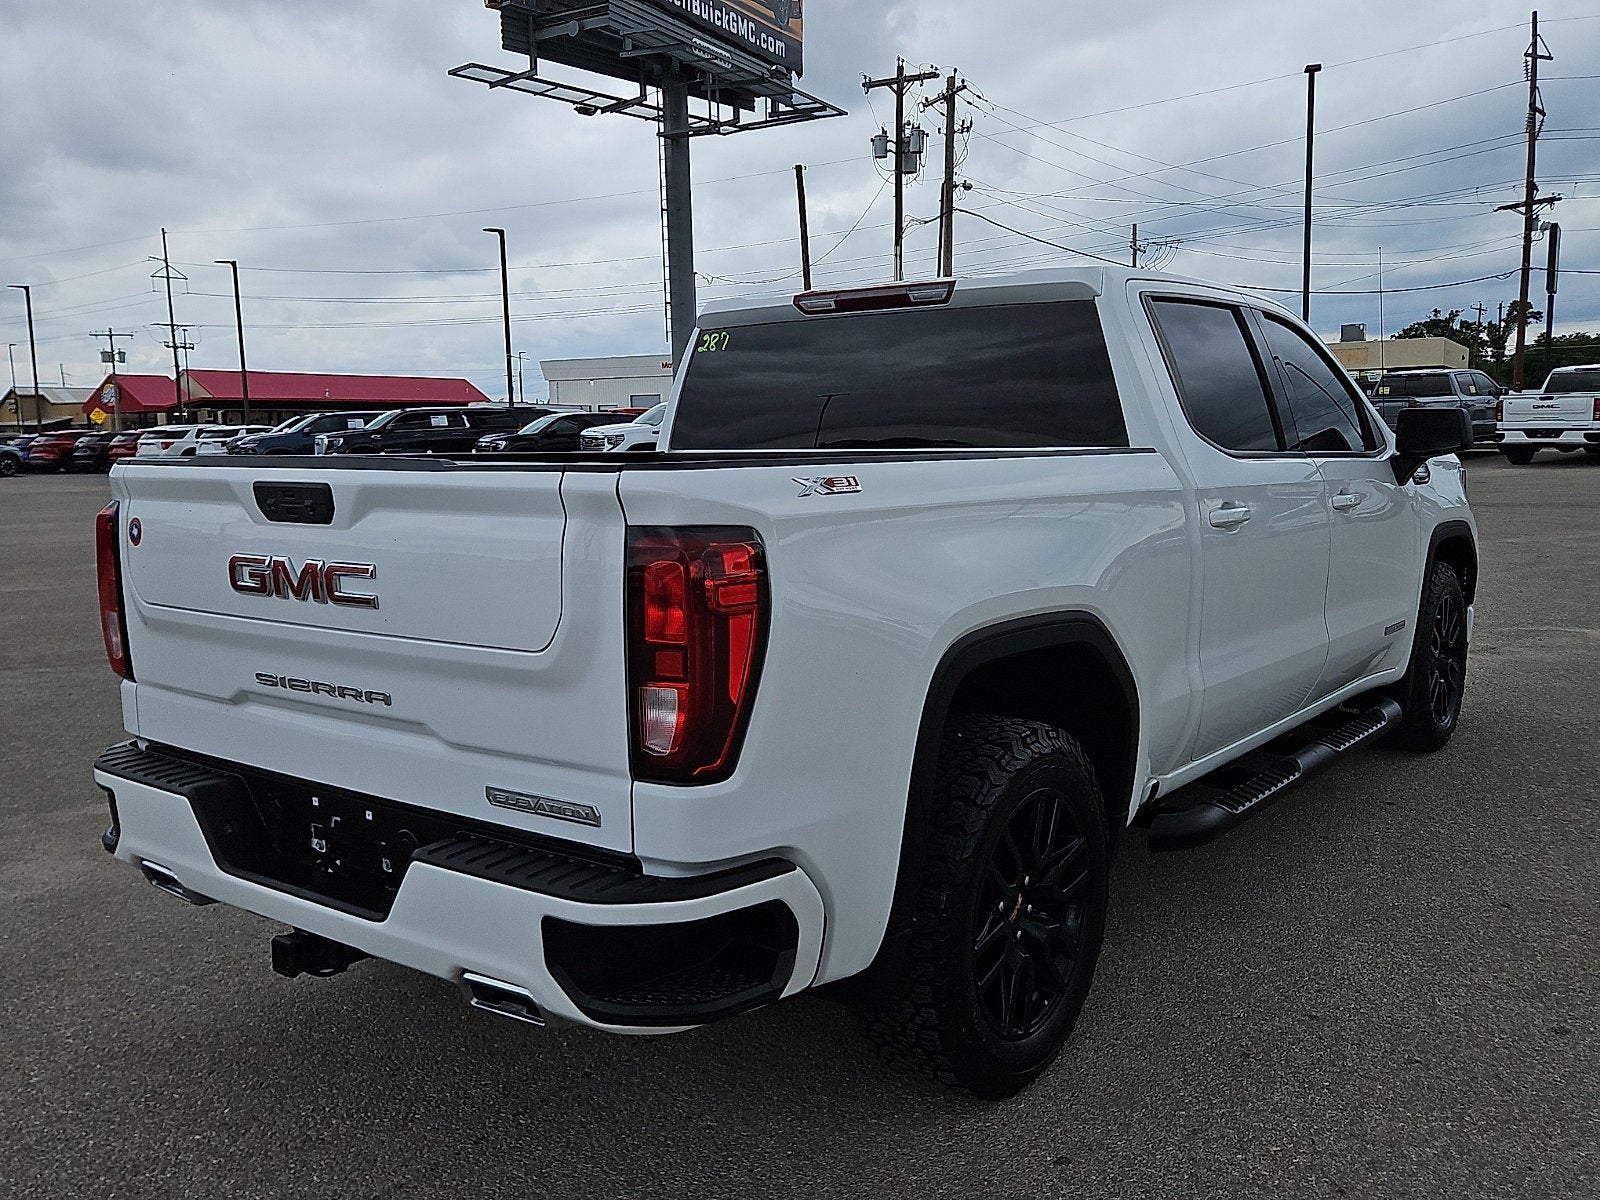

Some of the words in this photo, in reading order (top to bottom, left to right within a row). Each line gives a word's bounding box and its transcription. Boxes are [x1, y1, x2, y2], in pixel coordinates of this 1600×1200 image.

[697, 331, 730, 352] 287
[228, 553, 379, 609] GMC
[255, 672, 392, 706] SIERRA
[493, 791, 592, 818] ELEVATION
